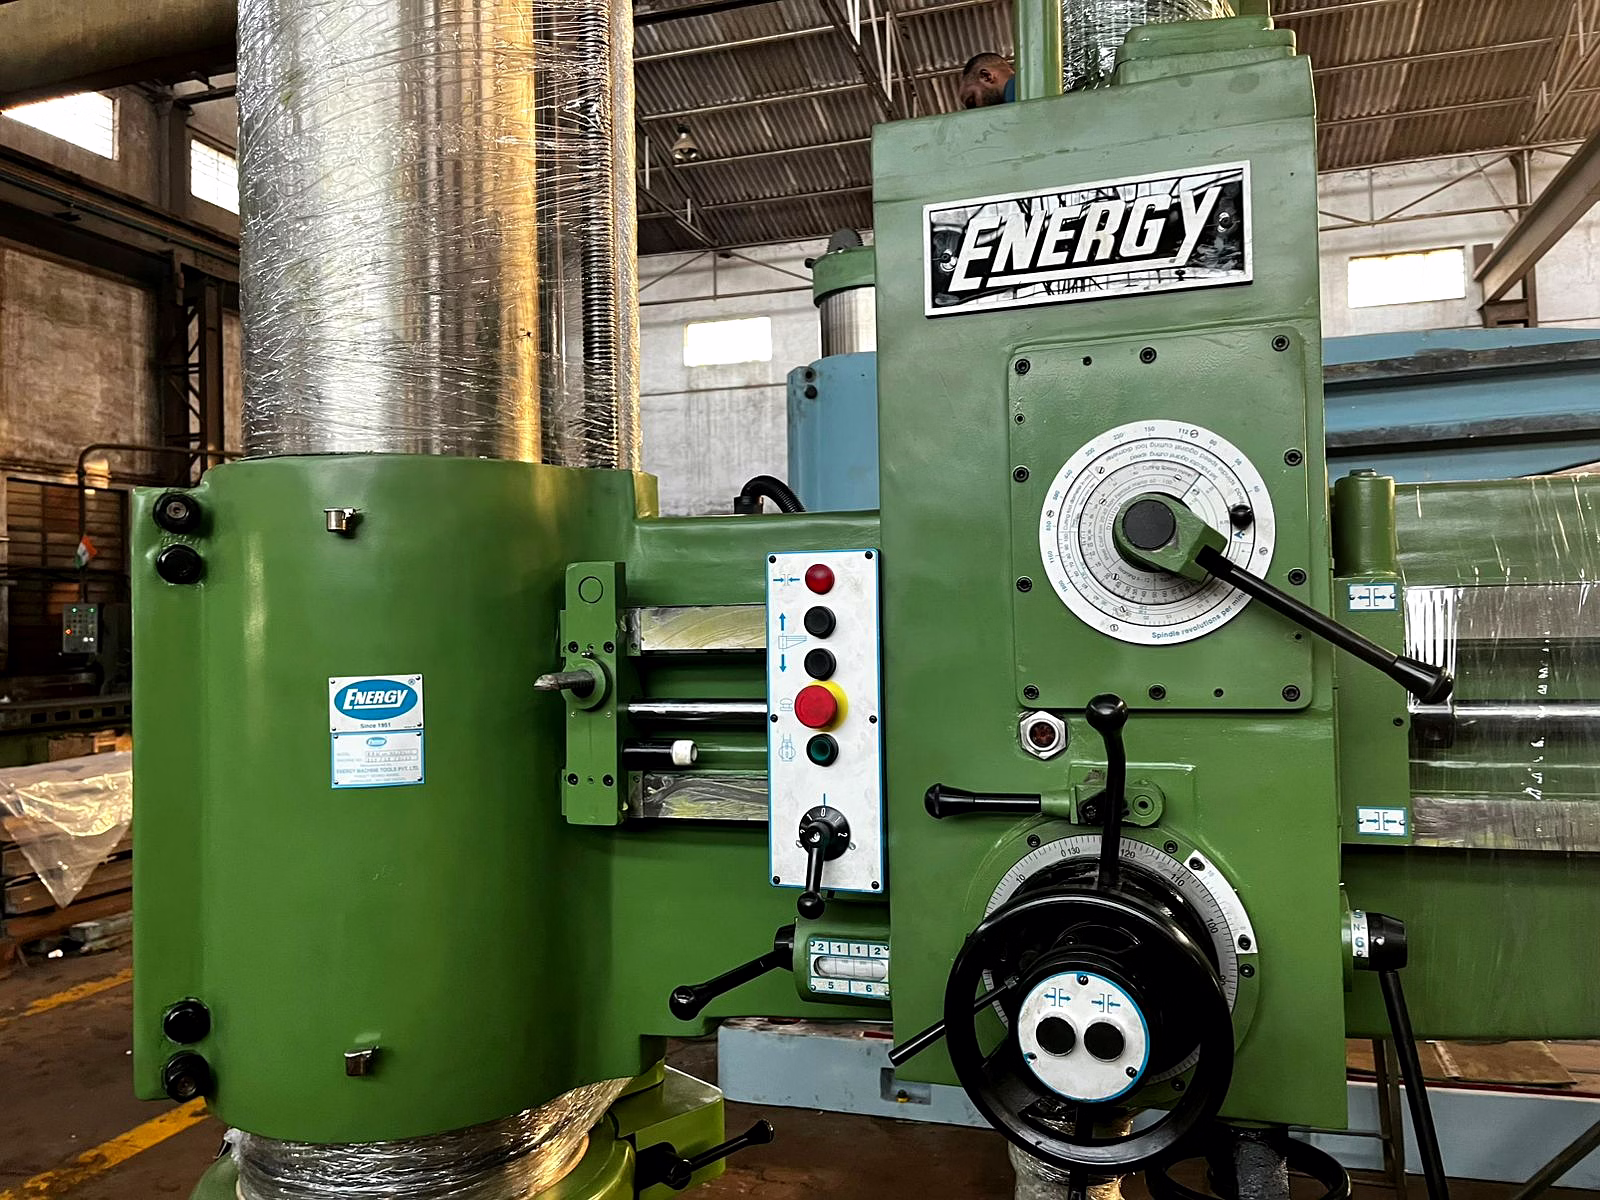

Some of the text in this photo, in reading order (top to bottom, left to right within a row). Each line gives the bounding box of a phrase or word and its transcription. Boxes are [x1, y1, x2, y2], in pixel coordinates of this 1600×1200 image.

[949, 186, 1222, 292] ENERGY
[1104, 446, 1133, 462] diameter
[1129, 452, 1146, 460] speed
[1174, 443, 1199, 456] against
[1198, 452, 1218, 467] speed
[1182, 614, 1220, 635] revolutions
[1221, 606, 1232, 616] per
[343, 688, 408, 710] ENERGY
[821, 807, 825, 817] 0
[1017, 874, 1025, 883] 10
[1067, 847, 1080, 855] 130
[1121, 850, 1136, 859] 120
[1170, 874, 1185, 886] 110
[1206, 918, 1218, 934] 100
[1355, 937, 1364, 948] 6
